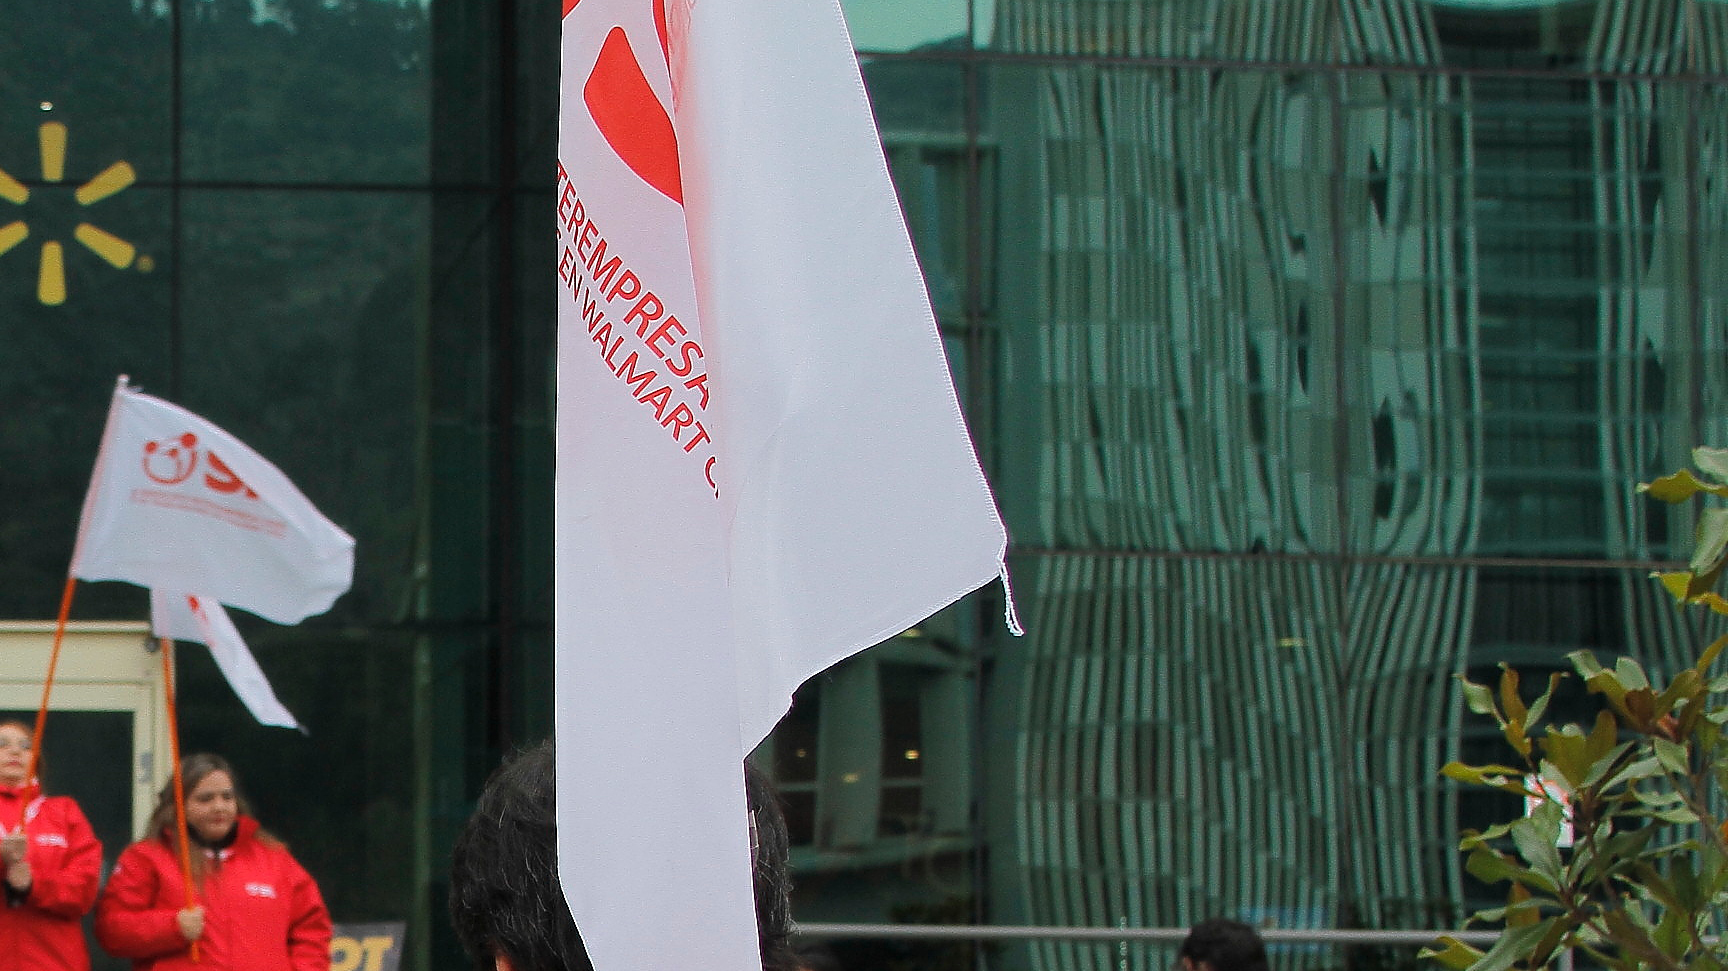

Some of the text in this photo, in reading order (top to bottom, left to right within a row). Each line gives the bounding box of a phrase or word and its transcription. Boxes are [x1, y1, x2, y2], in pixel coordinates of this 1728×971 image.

[556, 162, 710, 411] TEREMPRESA
[558, 246, 584, 303] EN
[581, 286, 712, 453] WALMART
